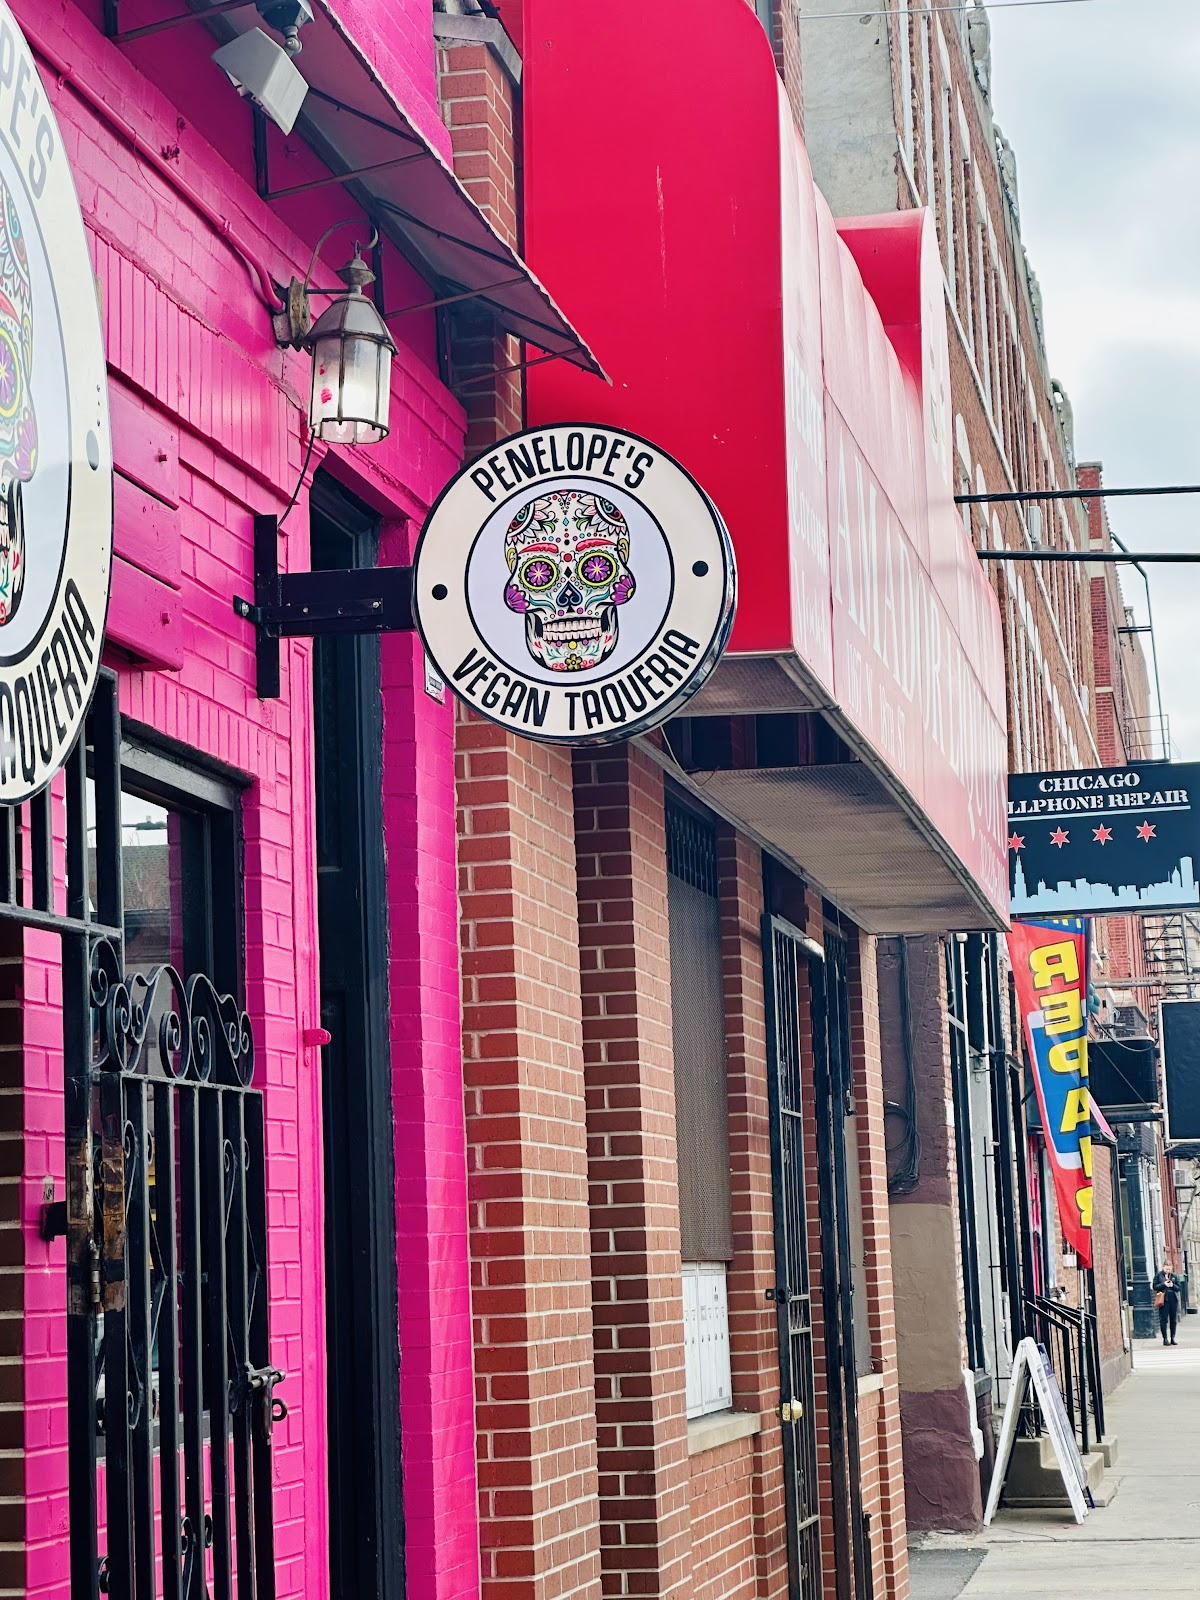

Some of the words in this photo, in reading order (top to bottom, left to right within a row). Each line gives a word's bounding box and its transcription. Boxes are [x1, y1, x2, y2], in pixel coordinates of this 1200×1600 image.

[469, 432, 654, 503] PENELOPE'S
[791, 452, 828, 577] Corona
[834, 425, 946, 756] AMADOR
[946, 625, 1008, 860] LIQUORS
[452, 648, 551, 727] VEGAN
[564, 628, 701, 731] TAQUERIA
[897, 704, 906, 772] ST
[1038, 772, 1141, 793] CHICAGO
[1108, 788, 1189, 808] REPAIR
